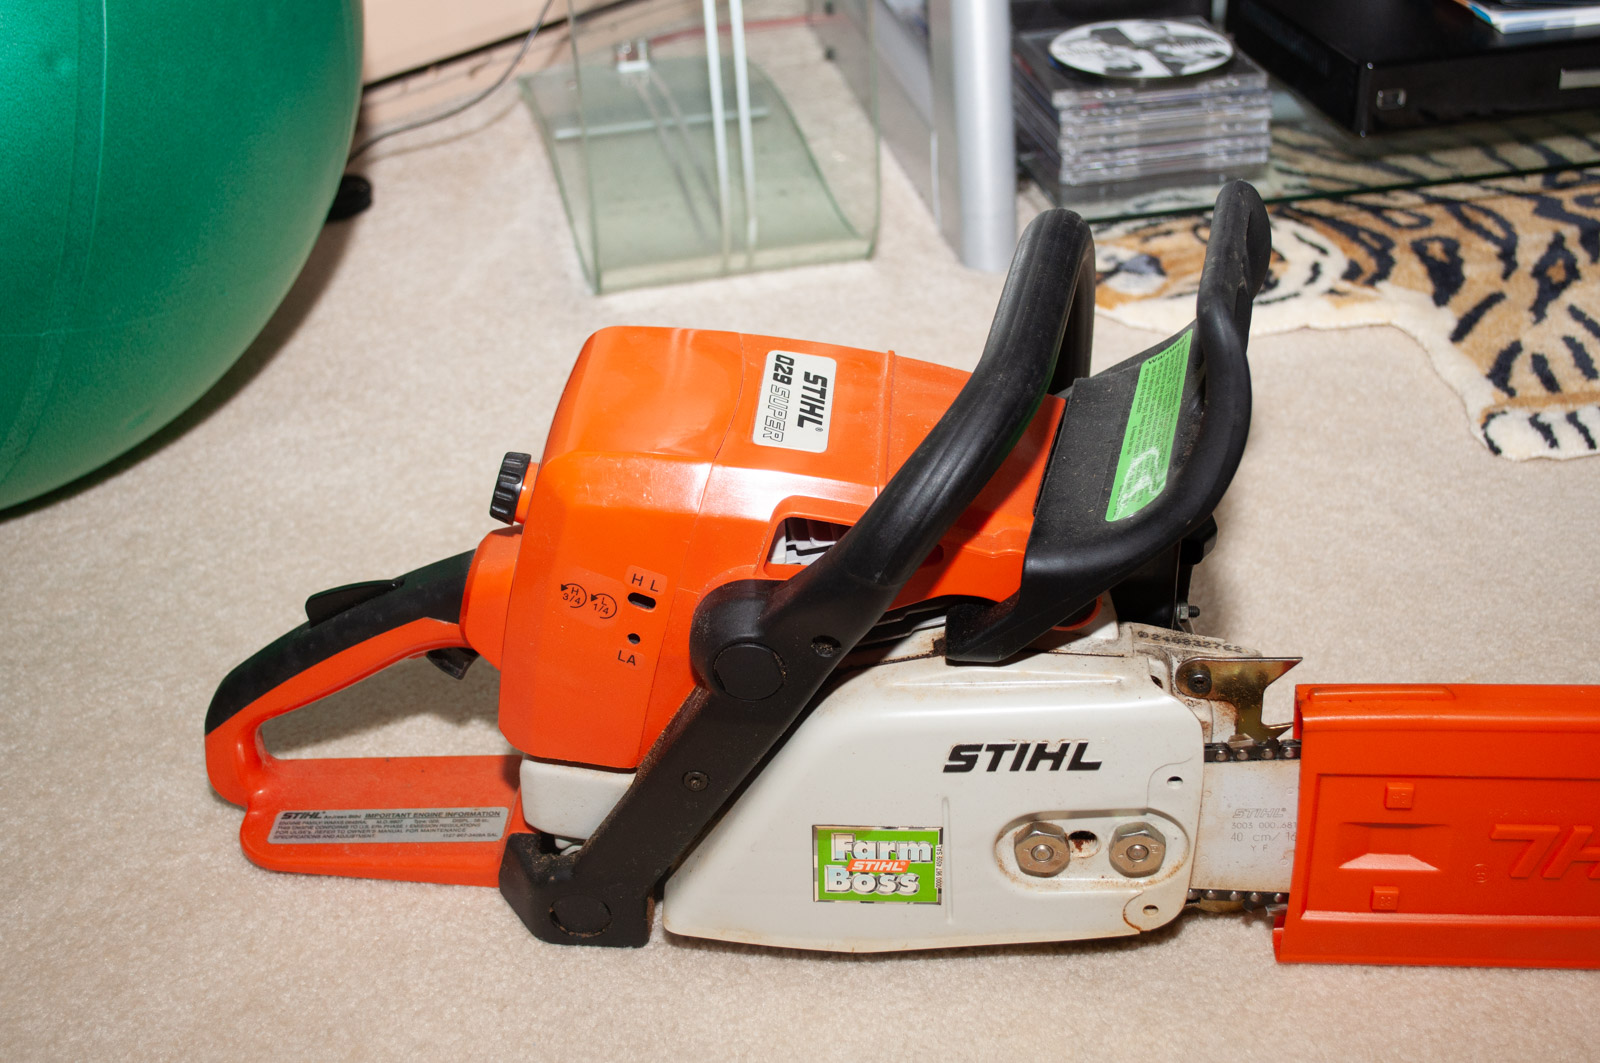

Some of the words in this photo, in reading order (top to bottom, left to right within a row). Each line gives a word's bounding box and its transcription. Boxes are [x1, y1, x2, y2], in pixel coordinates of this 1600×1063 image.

[772, 354, 795, 386] 029
[797, 371, 828, 429] STIHL
[762, 384, 791, 443] SUPER
[631, 573, 644, 587] H
[649, 579, 659, 593] L
[617, 650, 636, 666] LA
[942, 742, 1103, 773] STIHL
[281, 812, 322, 820] STIHL
[1232, 808, 1284, 819] STIHL
[1231, 822, 1253, 830] 3003
[1230, 831, 1243, 842] 40
[830, 832, 934, 864] Farm
[851, 861, 904, 872] STIHL
[824, 864, 920, 896] Boss
